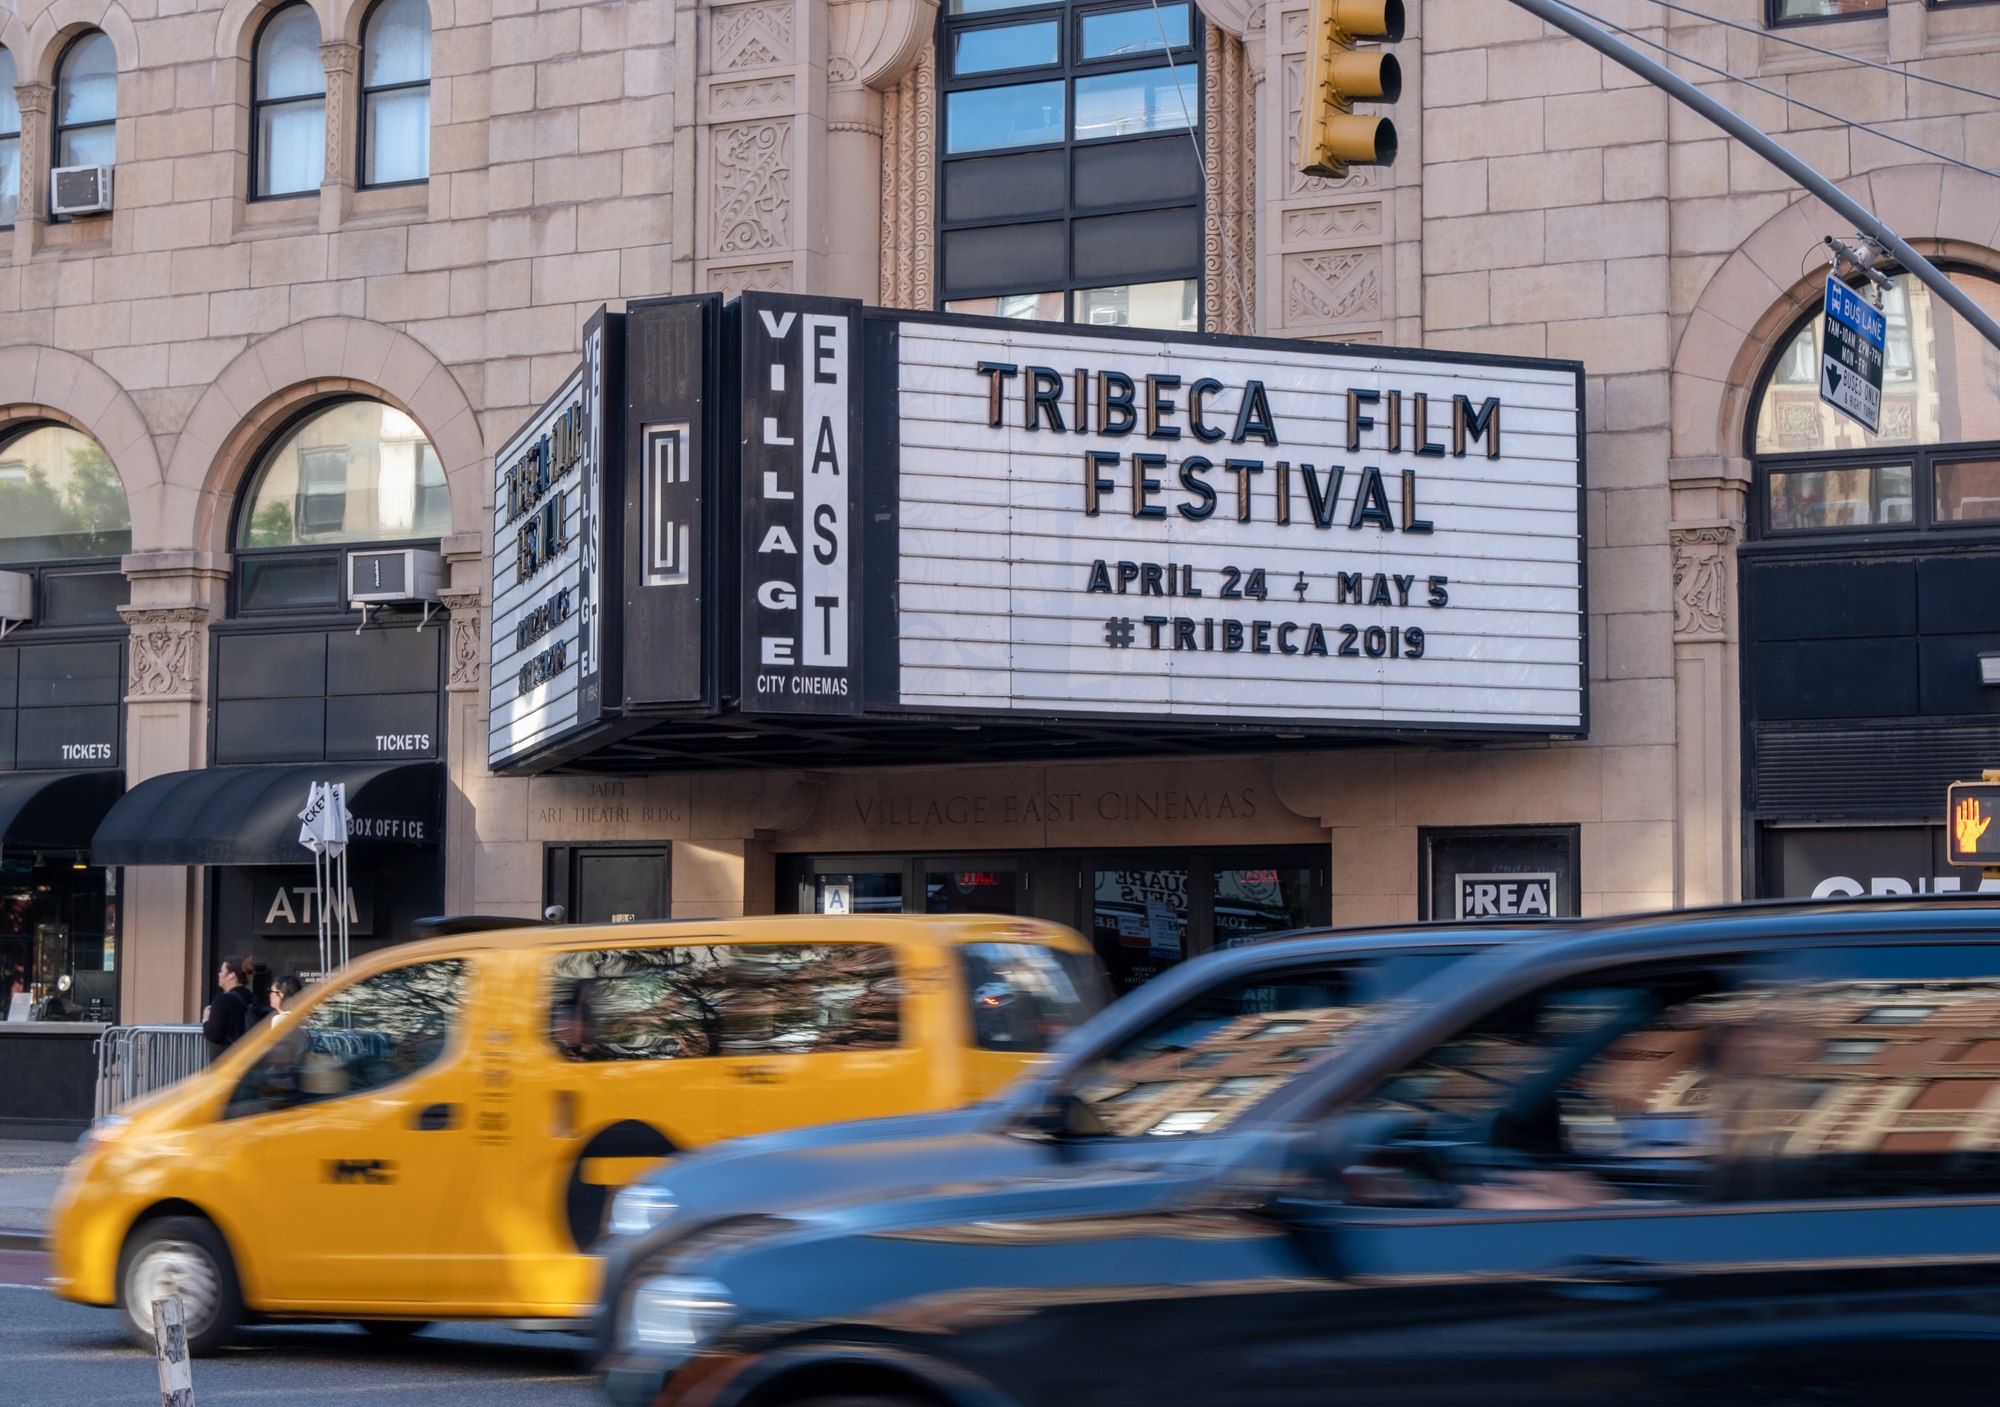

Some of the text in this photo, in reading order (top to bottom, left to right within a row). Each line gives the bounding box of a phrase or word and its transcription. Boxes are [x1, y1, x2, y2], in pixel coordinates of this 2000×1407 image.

[1844, 299, 1882, 340] BUS LANE
[1828, 317, 1882, 367] 7AM-10AM 2PM-7PM
[1843, 370, 1879, 408] BUSES ONLY
[977, 361, 1501, 460] TRIBECA FILM
[1849, 396, 1861, 414] RIGHT
[1863, 404, 1876, 422] TURNS
[757, 310, 797, 665] VILLAGE
[812, 325, 840, 656] EAST
[1085, 450, 1434, 534] FESTIVAL
[581, 338, 592, 678] VILLAGE
[1087, 559, 1202, 598] APRIL
[1219, 565, 1268, 600] 24
[1337, 571, 1415, 607] MAY
[1428, 575, 1449, 608] 5
[757, 675, 848, 696] CITY CINEMAS
[62, 743, 111, 760] TICKETS
[375, 733, 430, 751] TICKETS
[539, 806, 681, 823] ART THEATRE BLDG
[853, 788, 1258, 825] VILLAGE EAST CINEMAS
[347, 818, 424, 839] BOX OFFICE
[265, 886, 358, 924] ATM
[829, 889, 844, 908] A
